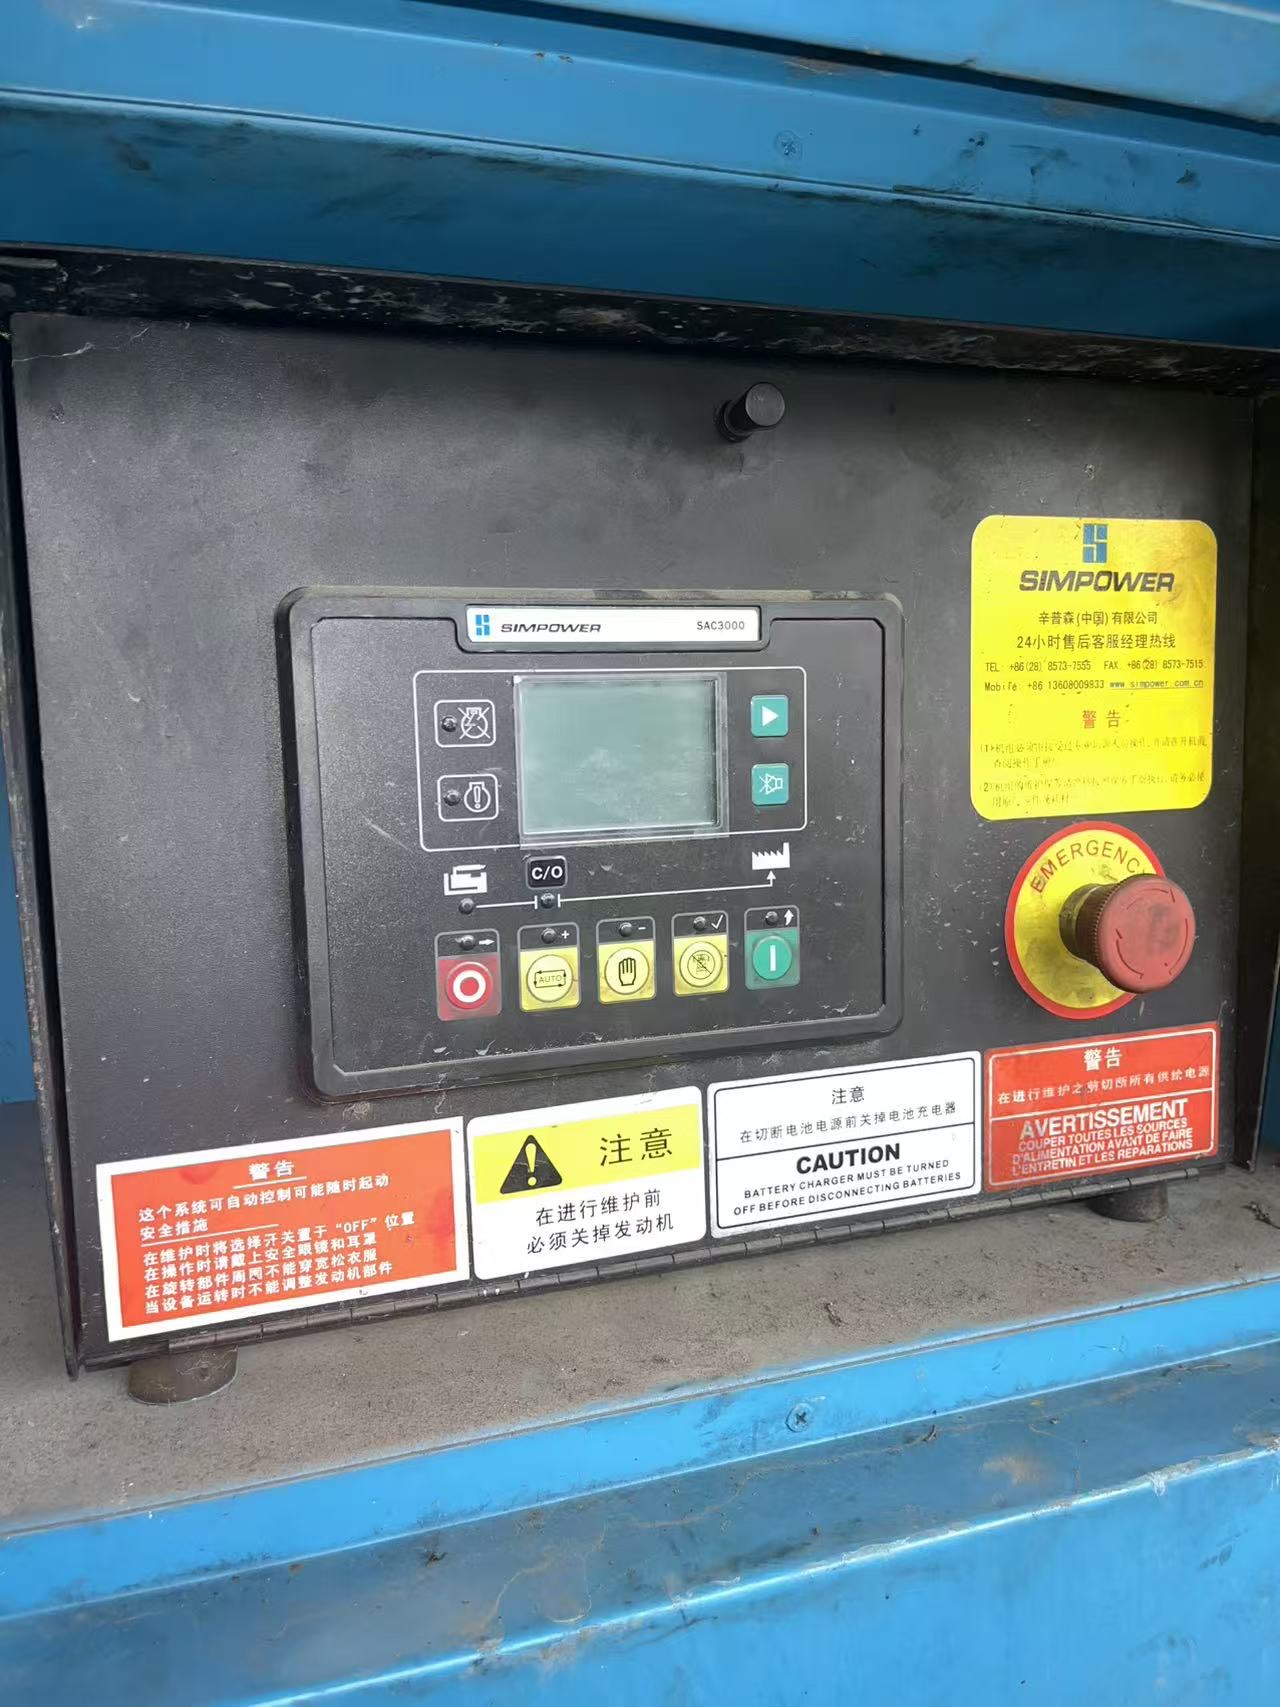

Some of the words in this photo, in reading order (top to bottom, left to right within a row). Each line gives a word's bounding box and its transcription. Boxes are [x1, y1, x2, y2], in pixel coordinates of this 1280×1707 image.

[1019, 570, 1175, 592] SIMPOWER
[500, 622, 602, 633] SIMPOWER
[696, 620, 745, 631] SAC3000
[1017, 634, 1176, 650] 24小时售后客服经理热线
[531, 865, 563, 881] C/O
[1030, 839, 1147, 894] EMERGENC
[538, 973, 563, 984] AUTO
[1083, 1047, 1122, 1072] 警告
[831, 1086, 865, 1105] 注意
[740, 1101, 957, 1144] 在切断电池电源前关掉电池充电器
[1018, 1136, 1066, 1152] COUPER
[1068, 1129, 1111, 1144] TOUTES
[1113, 1125, 1135, 1138] LES
[1136, 1118, 1188, 1134] SOURCES
[1019, 1098, 1188, 1140] AVERTISSEMENT
[600, 1127, 673, 1167] 注意
[796, 1142, 901, 1175] CAUTION
[1012, 1141, 1105, 1165] D'ALIMENTATION
[1107, 1135, 1143, 1149] AVANT
[1145, 1132, 1160, 1144] DE
[1162, 1128, 1193, 1142] FAIRE
[1079, 1154, 1092, 1165] ET
[1094, 1151, 1115, 1163] LES
[1117, 1138, 1193, 1160] REPARATIONS
[248, 1159, 295, 1181] 警告
[744, 1182, 795, 1199] BATTERY
[799, 1174, 854, 1190] CHARGER
[857, 1169, 887, 1181] MUST
[889, 1167, 903, 1176] BE
[906, 1159, 949, 1173] TURNED
[138, 1173, 389, 1223] 这个系统可自动控制可能随时起动
[535, 1188, 661, 1227] 在进行维护前
[733, 1204, 755, 1216] OFF
[759, 1196, 805, 1212] BEFORE
[808, 1182, 900, 1204] DISCONNECTING
[903, 1171, 961, 1189] BATTERIES
[140, 1217, 209, 1241] 安全措施
[527, 1213, 674, 1255] 必须关掉发动机
[144, 1232, 377, 1281] 在操作时请戴上安全眼镜和耳罩
[145, 1261, 393, 1314] 当设备运转时不能调整发动机部件
